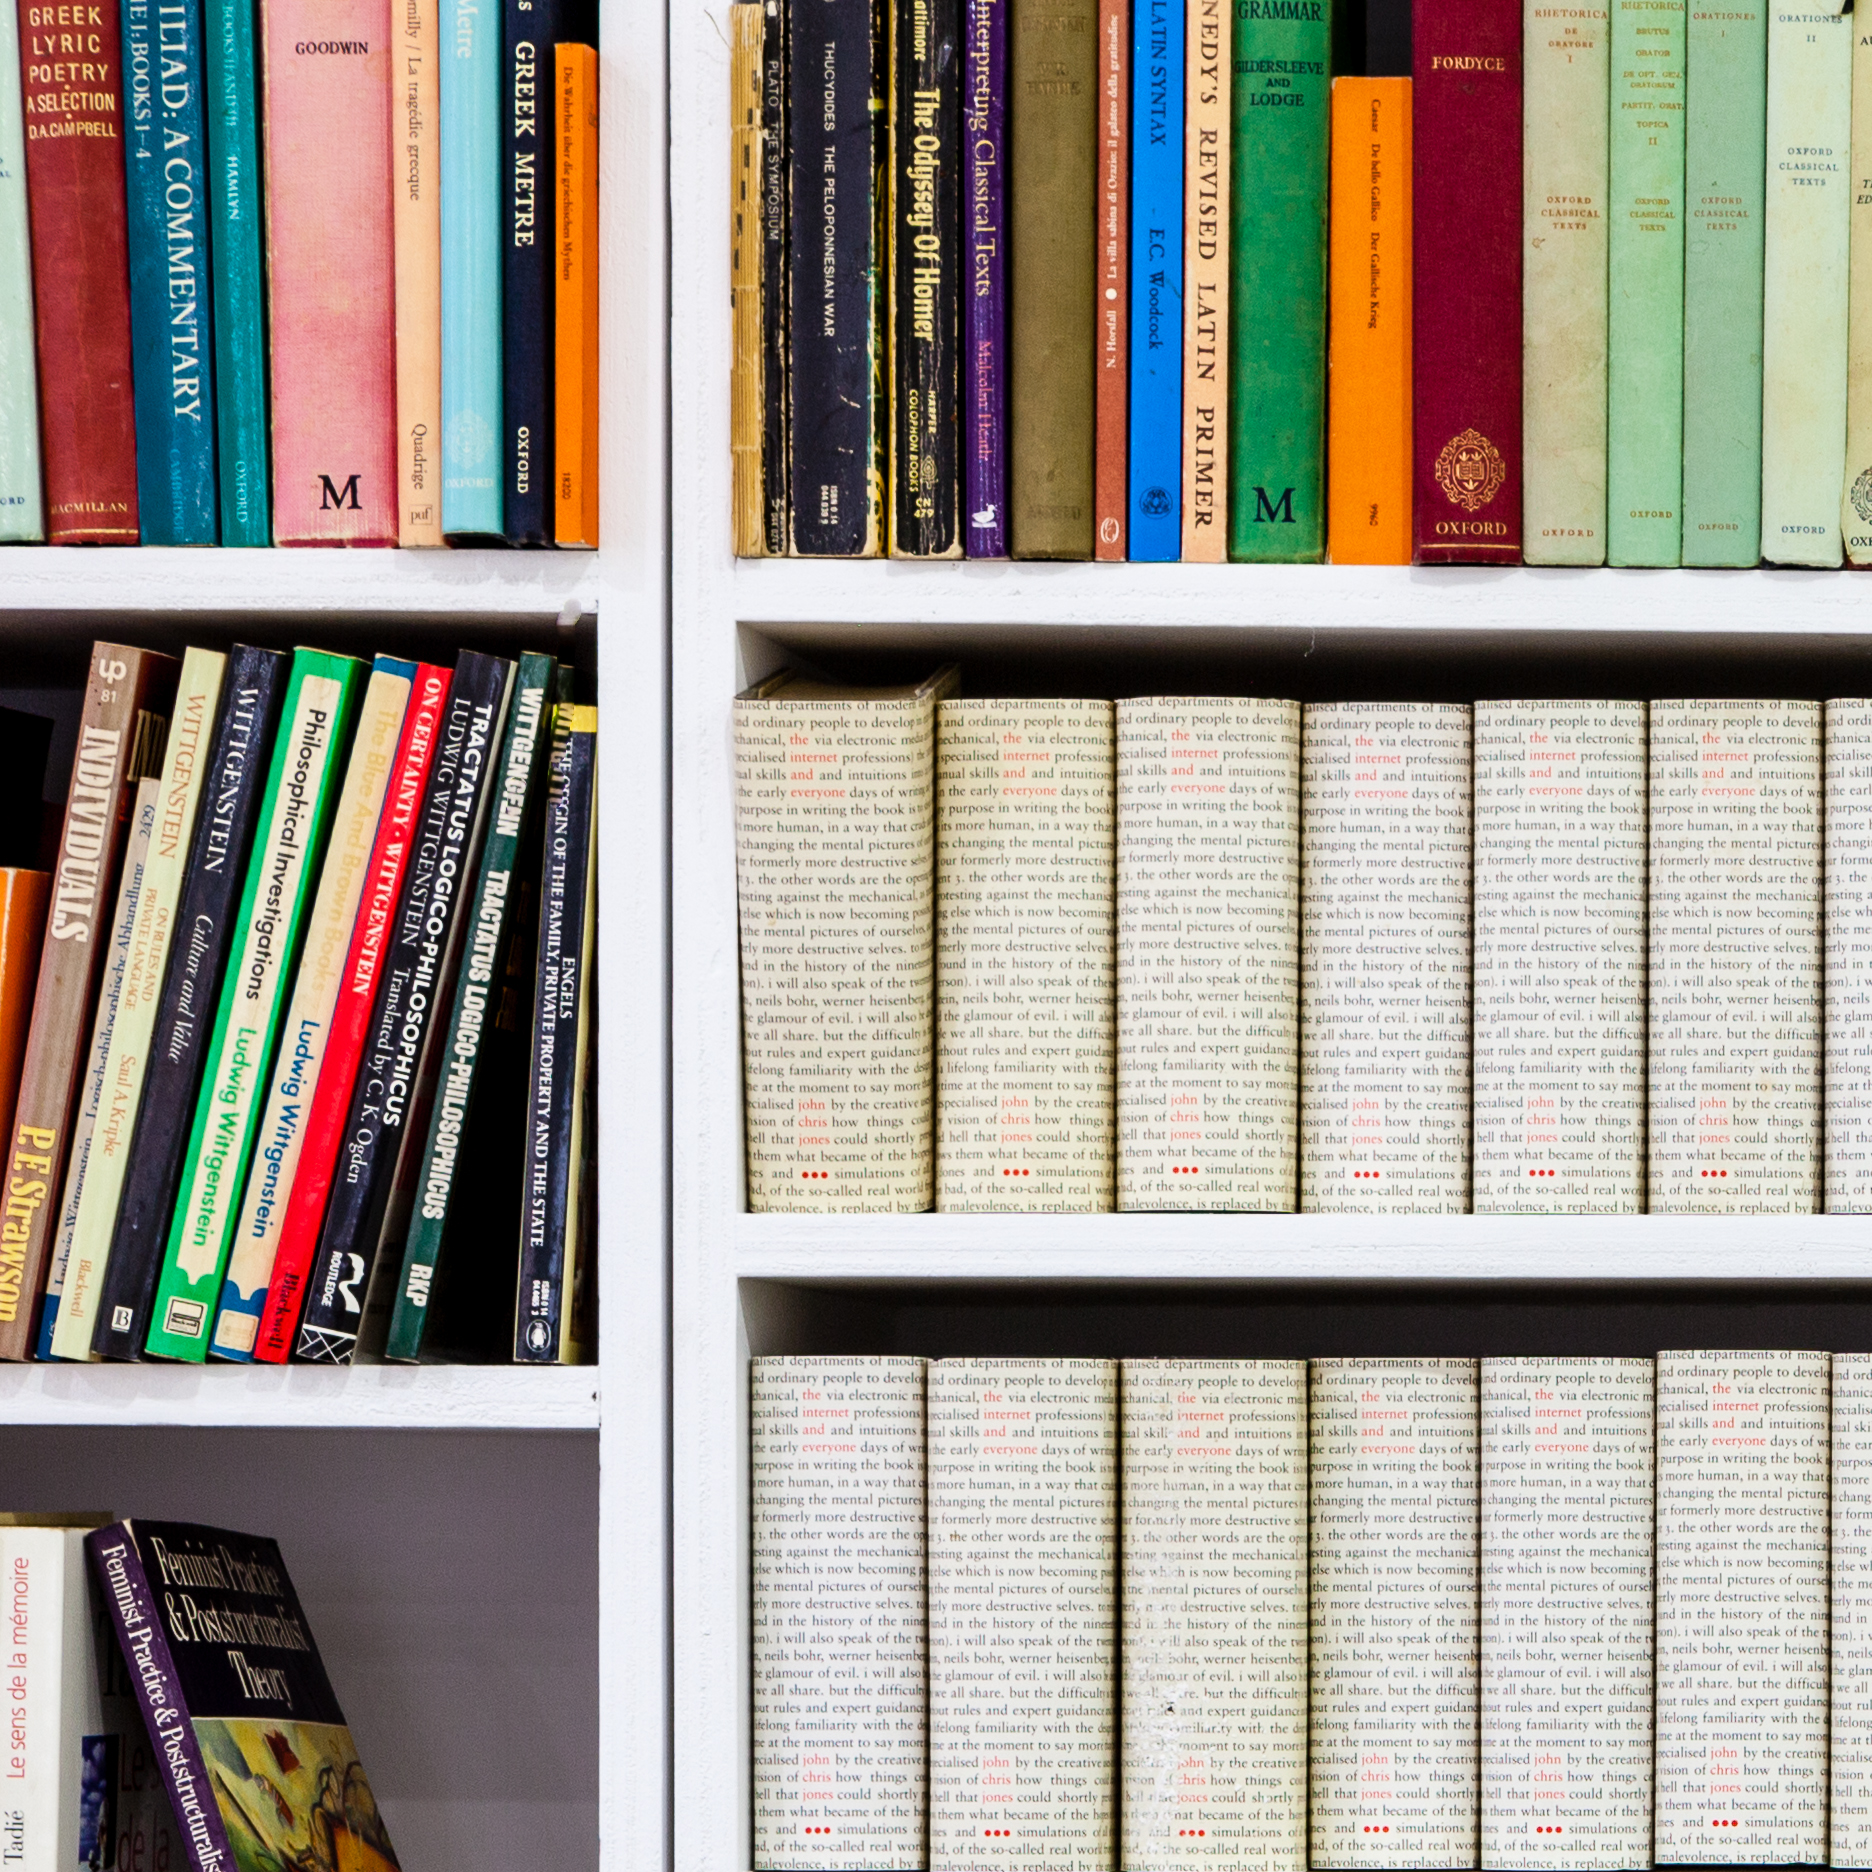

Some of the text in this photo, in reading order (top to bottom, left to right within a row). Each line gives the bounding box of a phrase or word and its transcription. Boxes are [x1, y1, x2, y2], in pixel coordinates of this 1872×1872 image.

[30, 6, 102, 26] GREEK
[33, 34, 99, 55] LYRIC
[30, 63, 108, 83] POETRY
[295, 42, 368, 54] GOODWIN
[1432, 57, 1504, 70] FORDYCE
[27, 92, 115, 114] A SELECTION
[406, 58, 422, 200] La tragédie grecque
[515, 41, 535, 246] GREEK METRE
[159, 6, 200, 421] ILIAD: A COMMENTARY
[907, 89, 941, 342] The Odyssey Of Homer
[1195, 129, 1217, 528] REVISED LATIN PRIMER
[318, 475, 362, 509] M
[1253, 487, 1296, 523] M
[205, 687, 259, 874] WITTGENSTEIN
[874, 804, 904, 814] book
[51, 725, 121, 942] INDIVIDUALS
[193, 708, 327, 1246] Philosophical Investigations Ludwig Wittgenstein
[560, 957, 575, 1018] ENGELS
[406, 870, 510, 1307] TRACTATUS LOGICO-PHILOSOPHICUS RKP
[7, 1558, 29, 1778] Le sens de la mémoire
[228, 1651, 293, 1713] Theory
